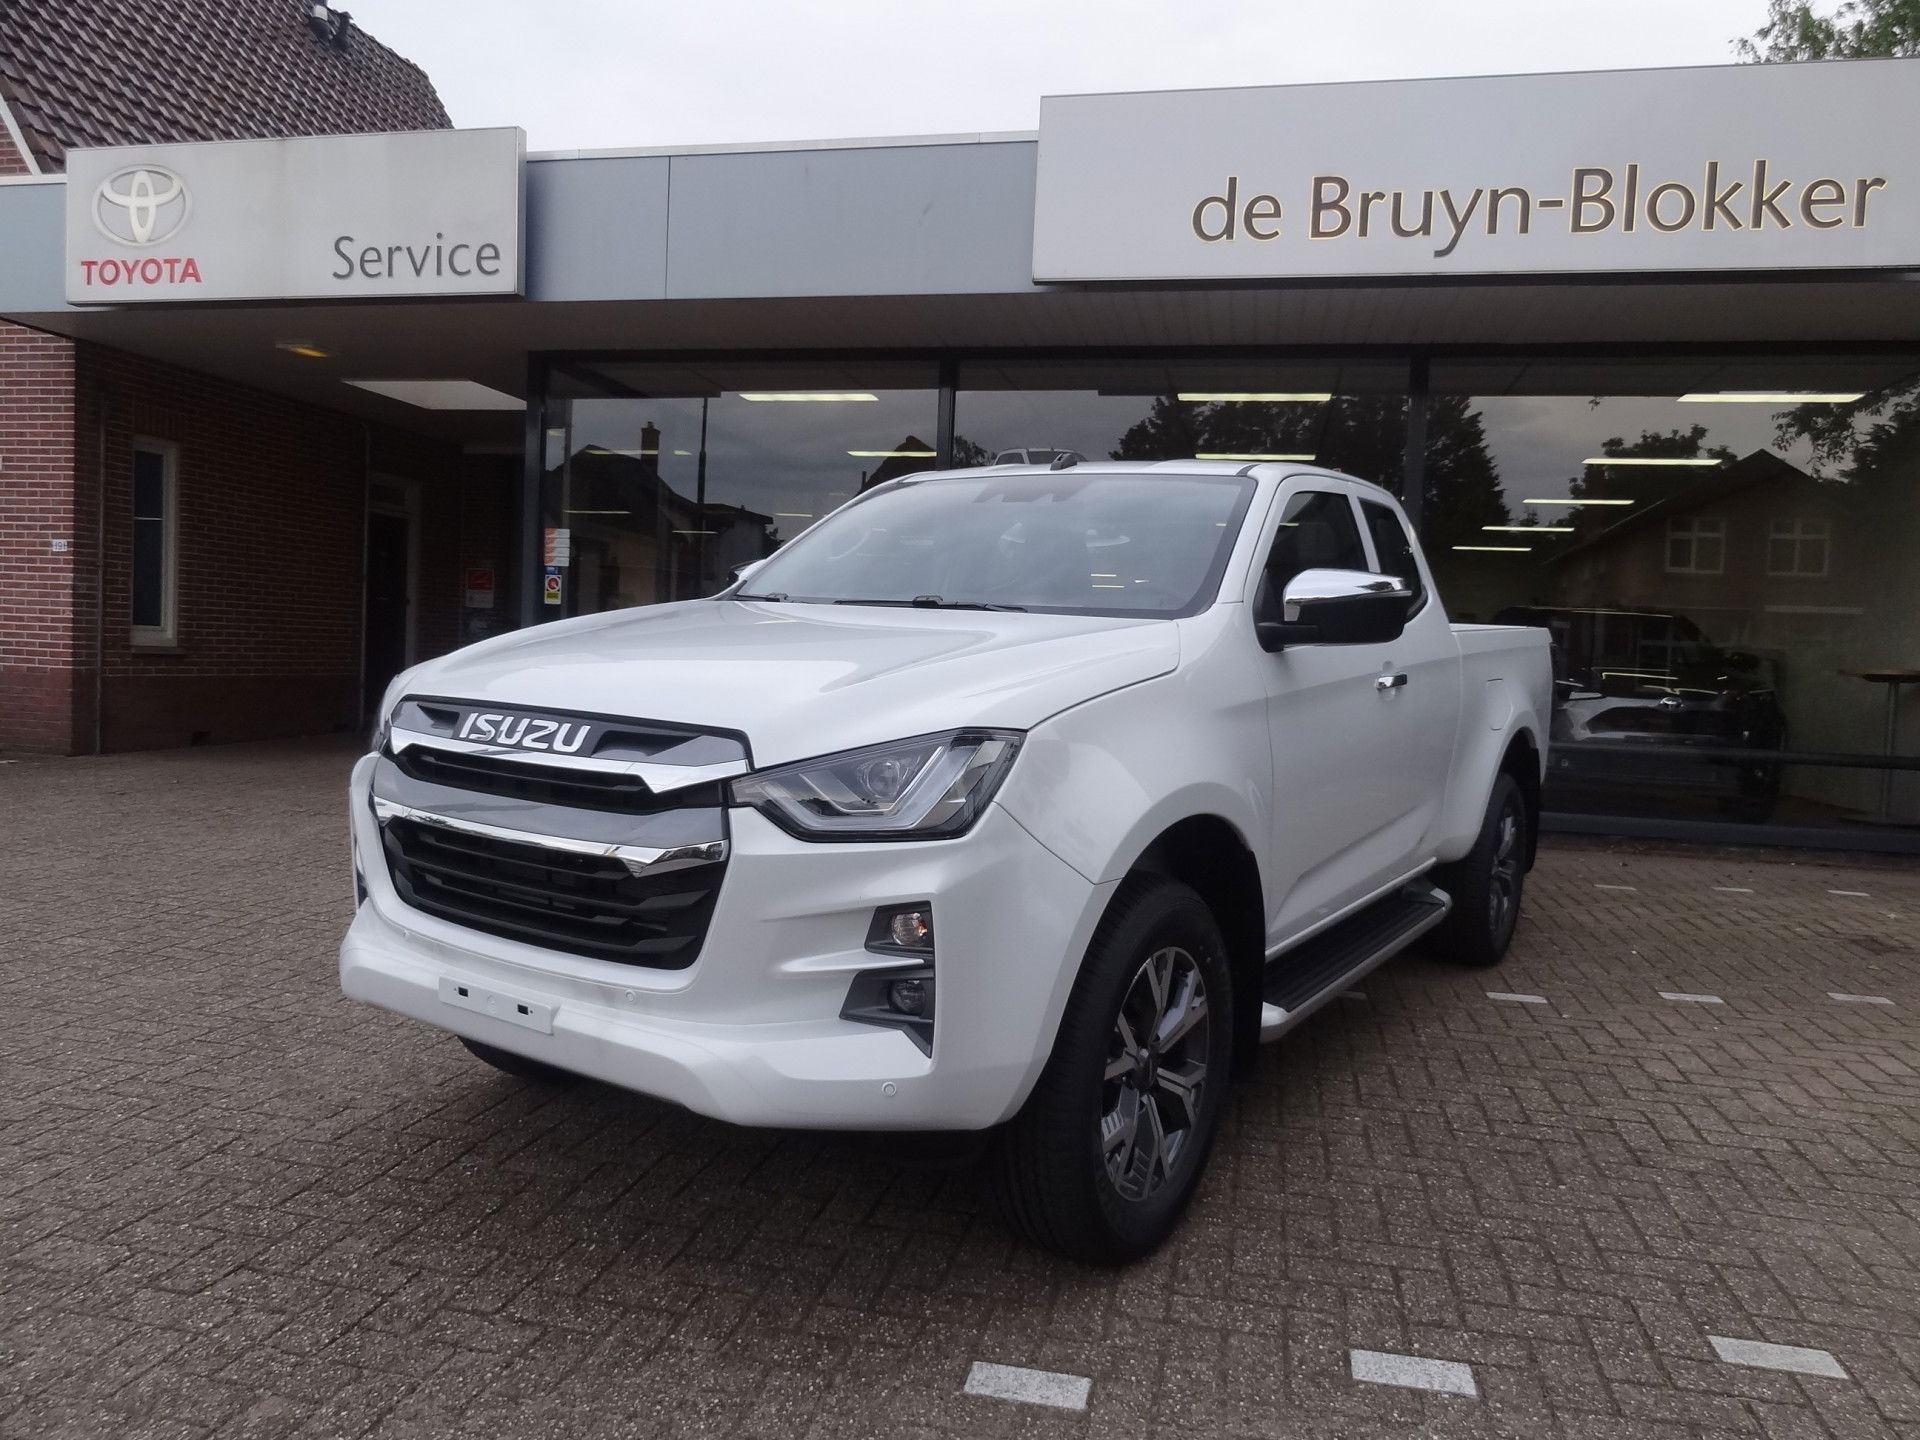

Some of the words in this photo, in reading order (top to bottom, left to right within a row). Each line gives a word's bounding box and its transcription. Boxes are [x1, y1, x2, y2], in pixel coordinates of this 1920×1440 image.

[1192, 176, 1283, 242] de
[1309, 159, 1888, 258] Bruyn-Blokker
[81, 258, 202, 286] TOYOTA
[332, 232, 501, 280] Service
[459, 712, 592, 752] ISUZU
